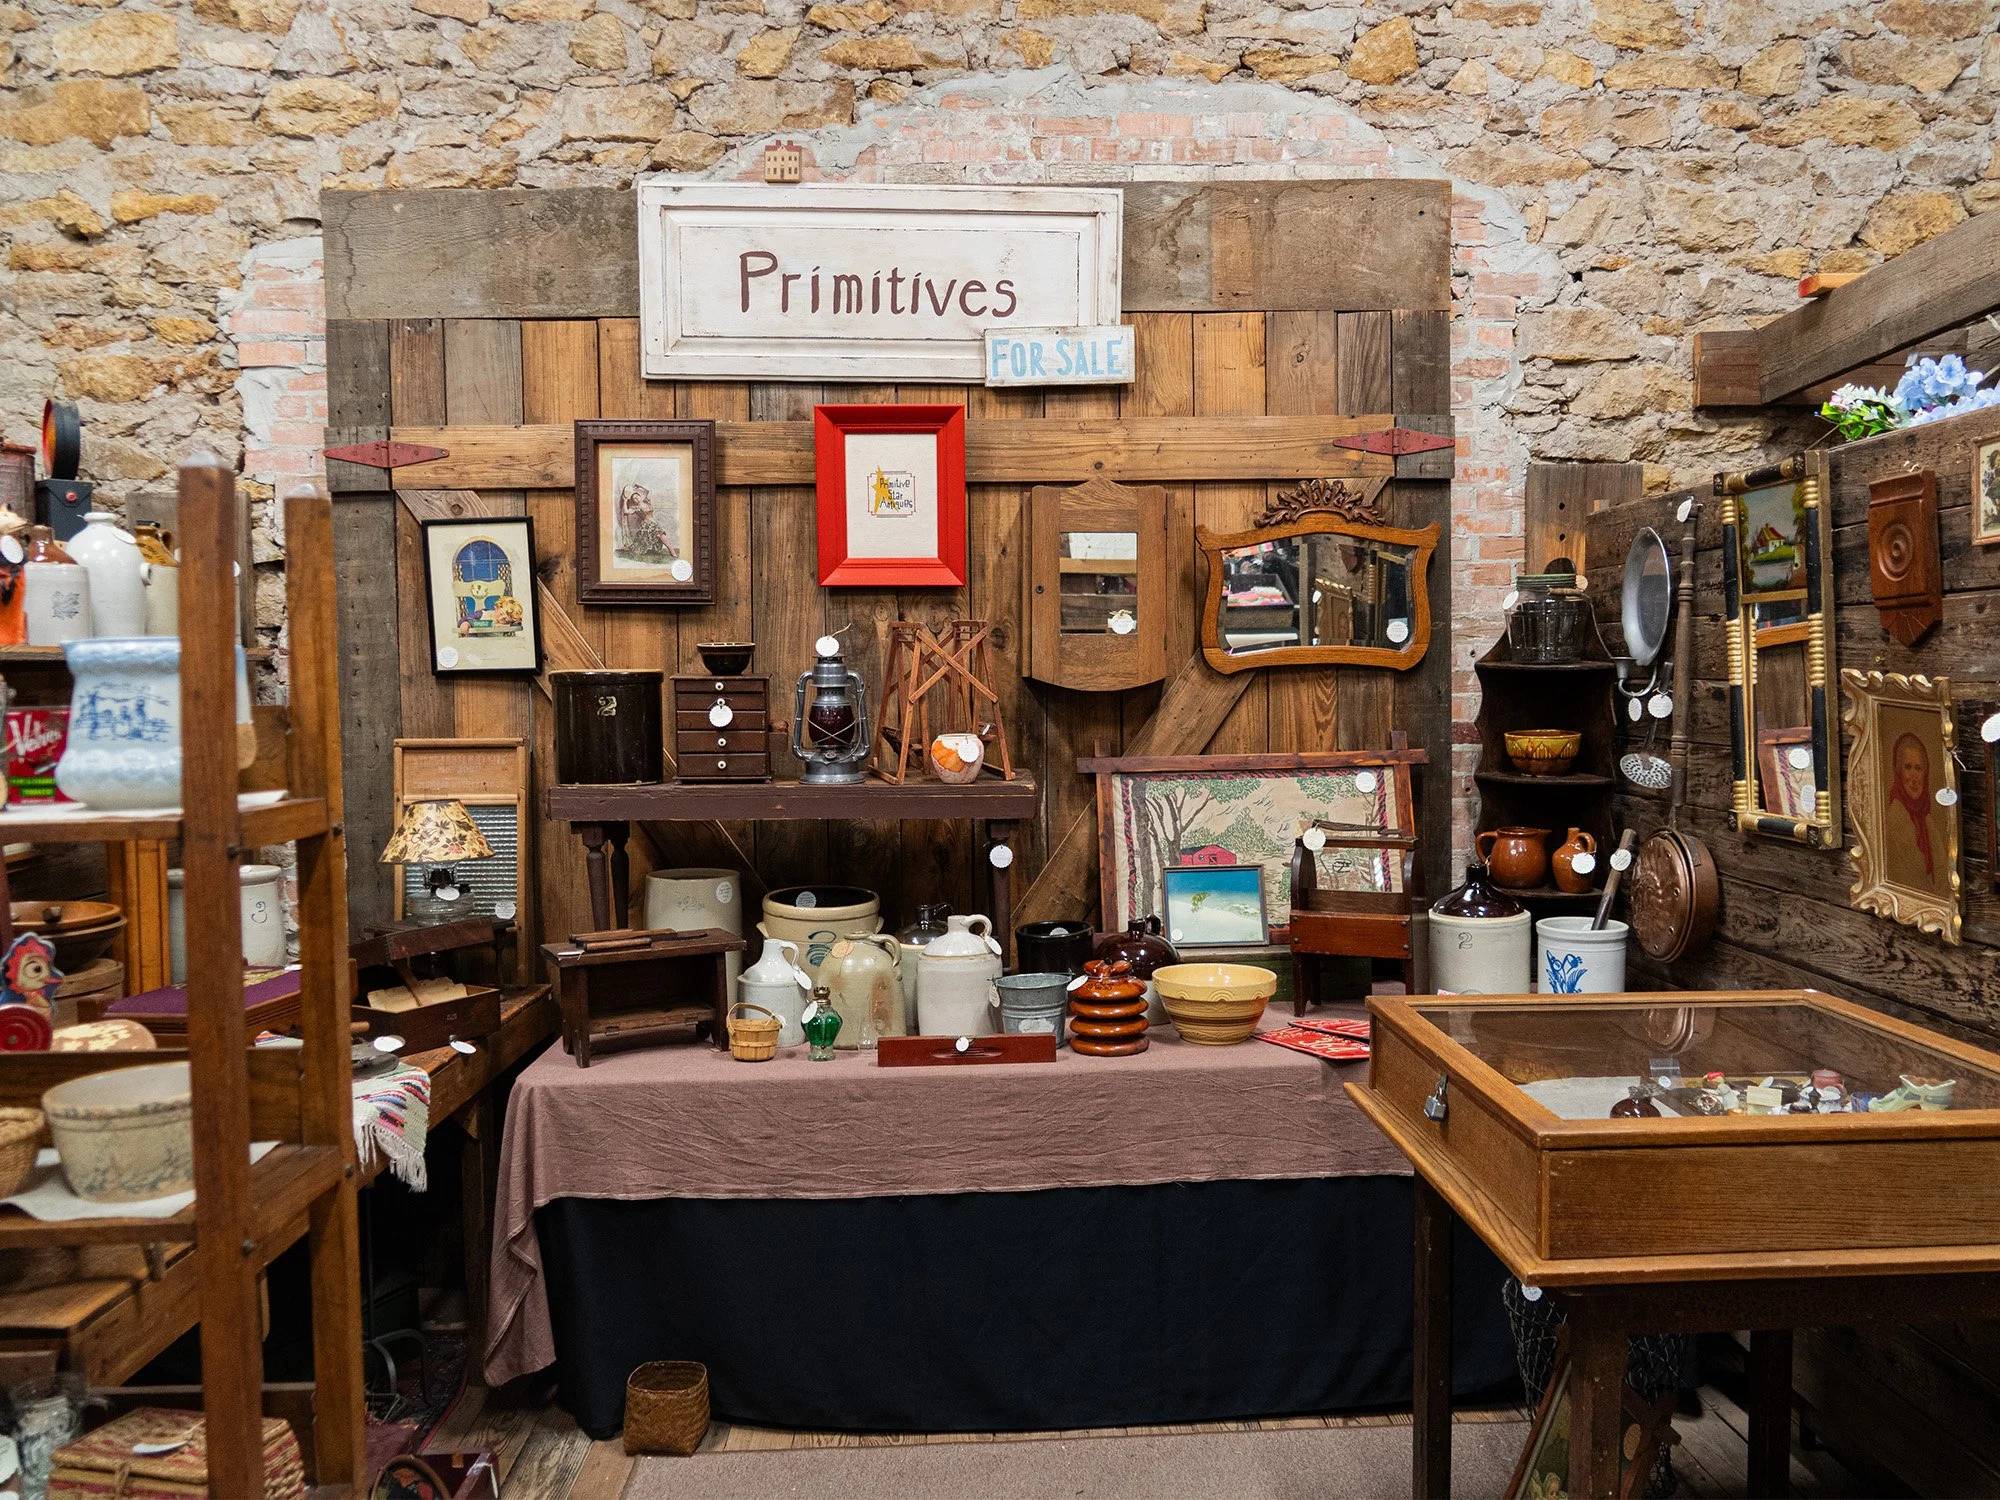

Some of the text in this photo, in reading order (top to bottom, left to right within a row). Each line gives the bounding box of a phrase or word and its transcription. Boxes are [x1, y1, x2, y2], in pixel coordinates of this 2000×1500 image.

[738, 250, 1018, 319] Primitives
[991, 335, 1124, 379] FOR SALE
[879, 477, 911, 489] Primitive
[879, 496, 913, 510] Antiques
[887, 489, 904, 500] Star
[596, 695, 618, 717] 2
[1458, 931, 1474, 951] 2
